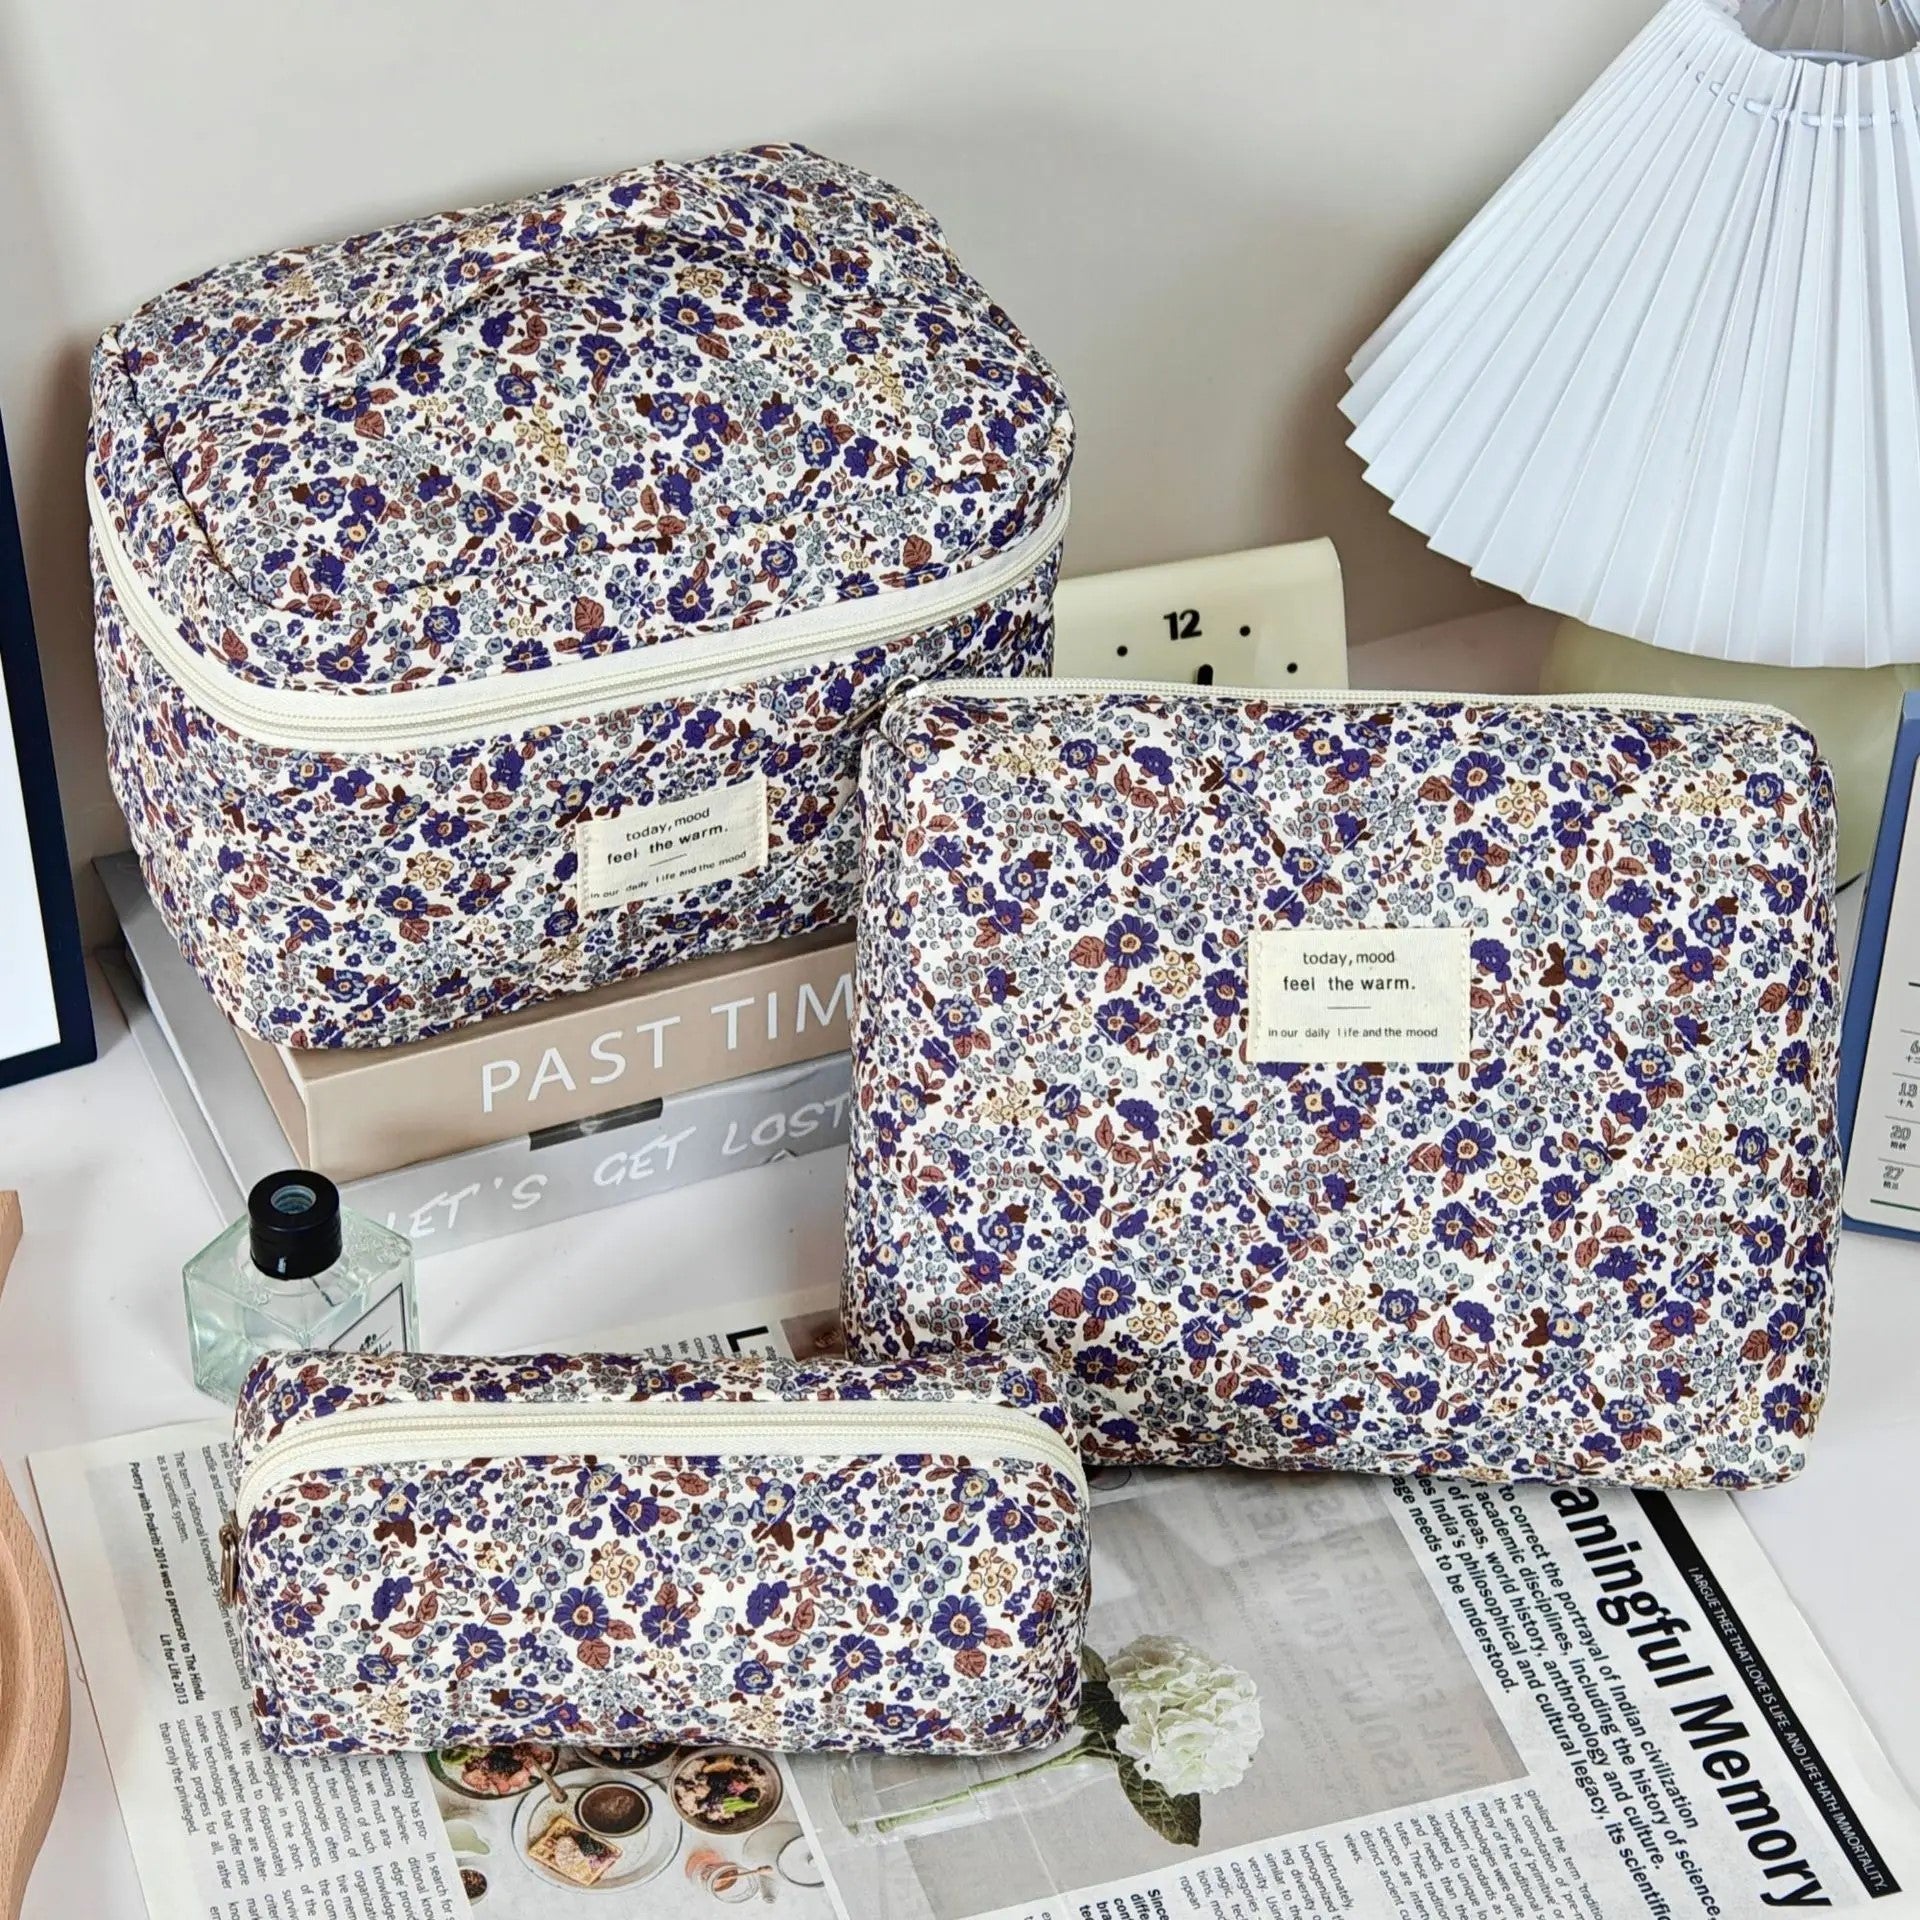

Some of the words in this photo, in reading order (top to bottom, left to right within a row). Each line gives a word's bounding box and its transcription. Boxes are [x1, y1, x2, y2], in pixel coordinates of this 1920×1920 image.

[1163, 609, 1202, 640] 12
[625, 822, 673, 842] today,
[674, 807, 710, 828] mood
[607, 848, 638, 865] feel
[649, 838, 674, 854] the
[679, 823, 728, 845] warm.
[590, 891, 601, 899] in
[602, 889, 620, 898] our
[625, 879, 649, 893] daily
[679, 866, 697, 877] and
[699, 861, 715, 872] the
[718, 850, 748, 866] mood
[1303, 951, 1353, 968] today,
[1356, 950, 1395, 964] mood
[1283, 975, 1315, 991] feel
[1328, 976, 1354, 991] the
[1360, 978, 1416, 991] warm.
[1268, 1028, 1278, 1037] in
[1280, 1029, 1298, 1038] our
[1305, 1028, 1330, 1040] daily
[1362, 1028, 1382, 1038] and
[1384, 1028, 1402, 1038] the
[1406, 1027, 1438, 1038] mood
[480, 1015, 681, 1113] PAST
[1898, 1081, 1918, 1098] 13
[593, 1125, 697, 1188] GET
[720, 1089, 851, 1156] LOST
[1890, 1124, 1912, 1141] 20
[1883, 1165, 1904, 1181] 27
[129, 1462, 144, 1491] Poetry
[137, 1491, 152, 1512] with
[1498, 1485, 1515, 1502] to
[143, 1512, 163, 1546] Prakriti
[1508, 1504, 1551, 1560] correct
[152, 1546, 170, 1570] 2014
[159, 1570, 173, 1589] was
[1541, 1561, 1564, 1588] the
[1408, 1506, 1442, 1553] needs
[1435, 1554, 1452, 1571] to
[1445, 1573, 1465, 1594] be
[1458, 1597, 1519, 1694] understood.
[1691, 1573, 1721, 1608] ARGUE
[165, 1597, 188, 1641] precursor
[1554, 1591, 1609, 1662] portrayal
[1713, 1607, 1737, 1636] THEE
[159, 1633, 173, 1647] Lit
[180, 1642, 191, 1653] to
[1729, 1634, 1754, 1662] THAT
[163, 1647, 176, 1662] for
[184, 1653, 197, 1672] The
[1474, 1488, 1526, 1565] academic
[1518, 1567, 1573, 1656] disciplines,
[1568, 1657, 1622, 1736] including
[1612, 1736, 1635, 1766] the
[1628, 1768, 1671, 1825] history
[1663, 1829, 1687, 1846] of
[167, 1662, 182, 1680] Life
[1447, 1485, 1467, 1501] of
[1457, 1502, 1489, 1550] ideas,
[1484, 1551, 1521, 1594] world
[1509, 1596, 1549, 1657] history,
[1542, 1660, 1611, 1766] anthropology
[1602, 1771, 1634, 1802] and
[1622, 1806, 1664, 1870] culture.
[1598, 1665, 1622, 1681] of
[1745, 1663, 1771, 1693] LOVE
[172, 1681, 189, 1705] 2013
[189, 1672, 206, 1701] Hindu
[1454, 1551, 1528, 1656] philosophical
[1516, 1659, 1546, 1690] and
[1535, 1693, 1582, 1756] cultural
[1570, 1759, 1610, 1820] legacy,
[1604, 1821, 1626, 1845] its
[1761, 1692, 1777, 1704] IS
[1609, 1684, 1647, 1737] Indian
[1768, 1704, 1791, 1728] LIFE.
[158, 1721, 172, 1745] than
[1783, 1732, 1807, 1756] AND
[164, 1745, 180, 1766] only
[1799, 1756, 1822, 1780] LIFE
[171, 1766, 184, 1784] the
[1640, 1740, 1699, 1829] civilization
[173, 1784, 200, 1835] privileged.
[1669, 1693, 1833, 1907] Memory
[1813, 1780, 1841, 1812] HATH
[1832, 1812, 1888, 1891] IMMORTALITY.
